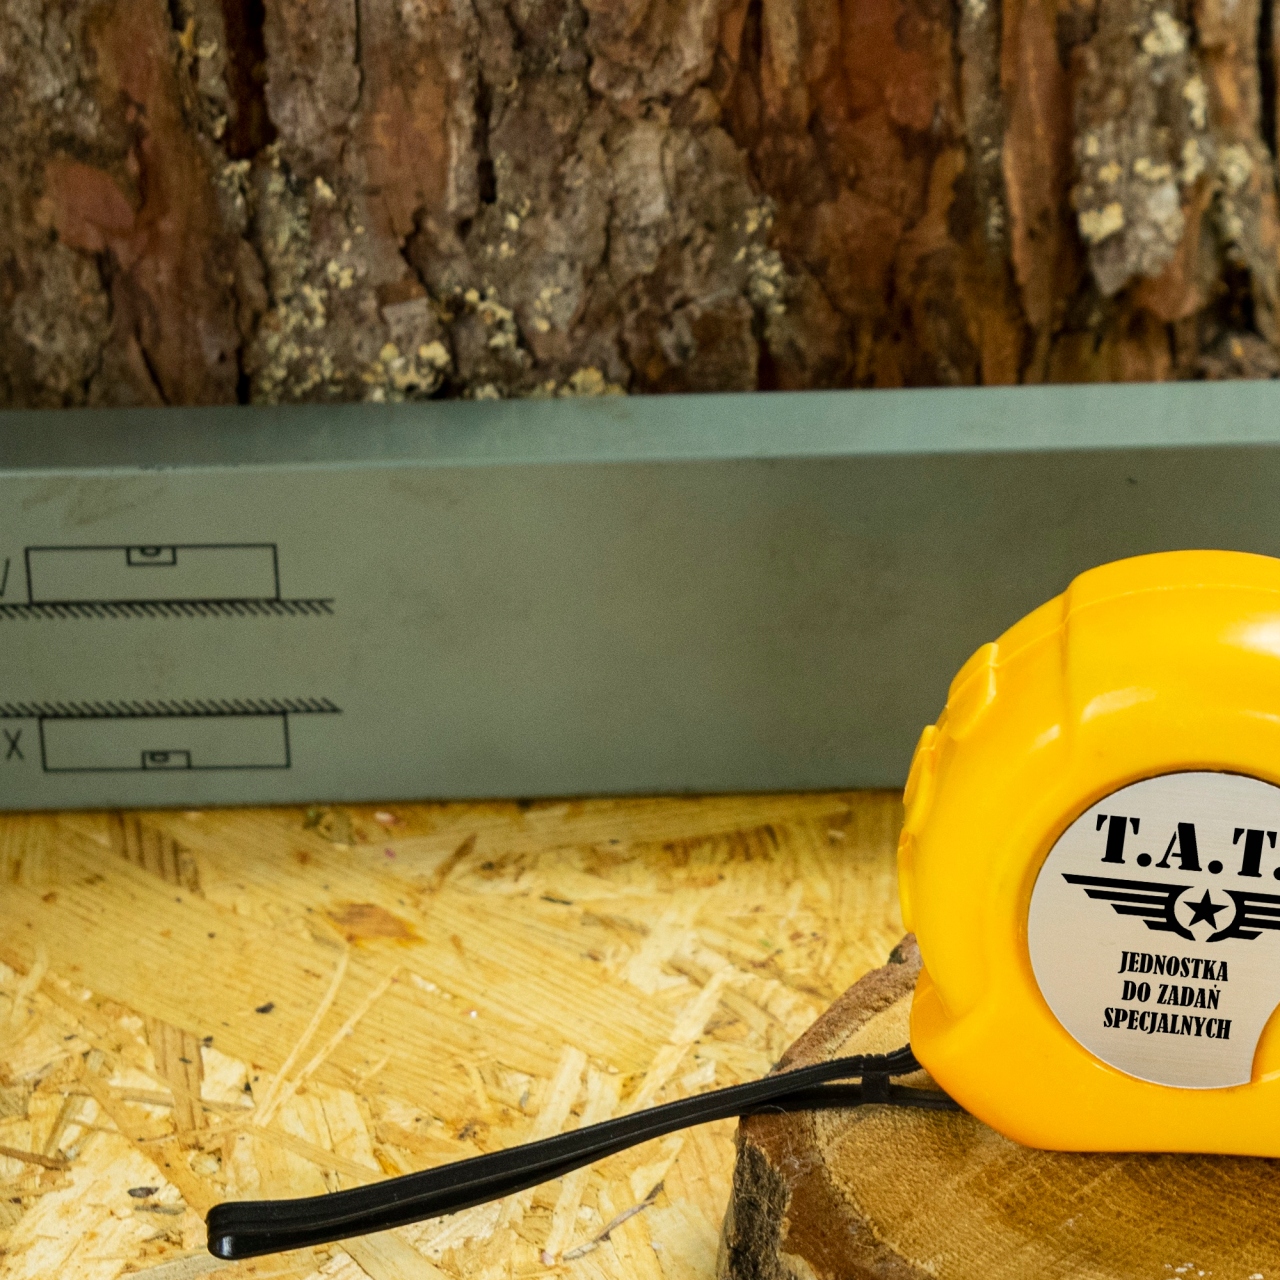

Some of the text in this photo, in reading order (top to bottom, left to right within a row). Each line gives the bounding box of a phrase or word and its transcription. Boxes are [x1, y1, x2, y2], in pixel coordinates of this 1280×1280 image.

[1117, 951, 1229, 982] JEDNOSTKA
[1121, 980, 1151, 1002] DO
[1103, 1007, 1232, 1040] SPECJALNYCH
